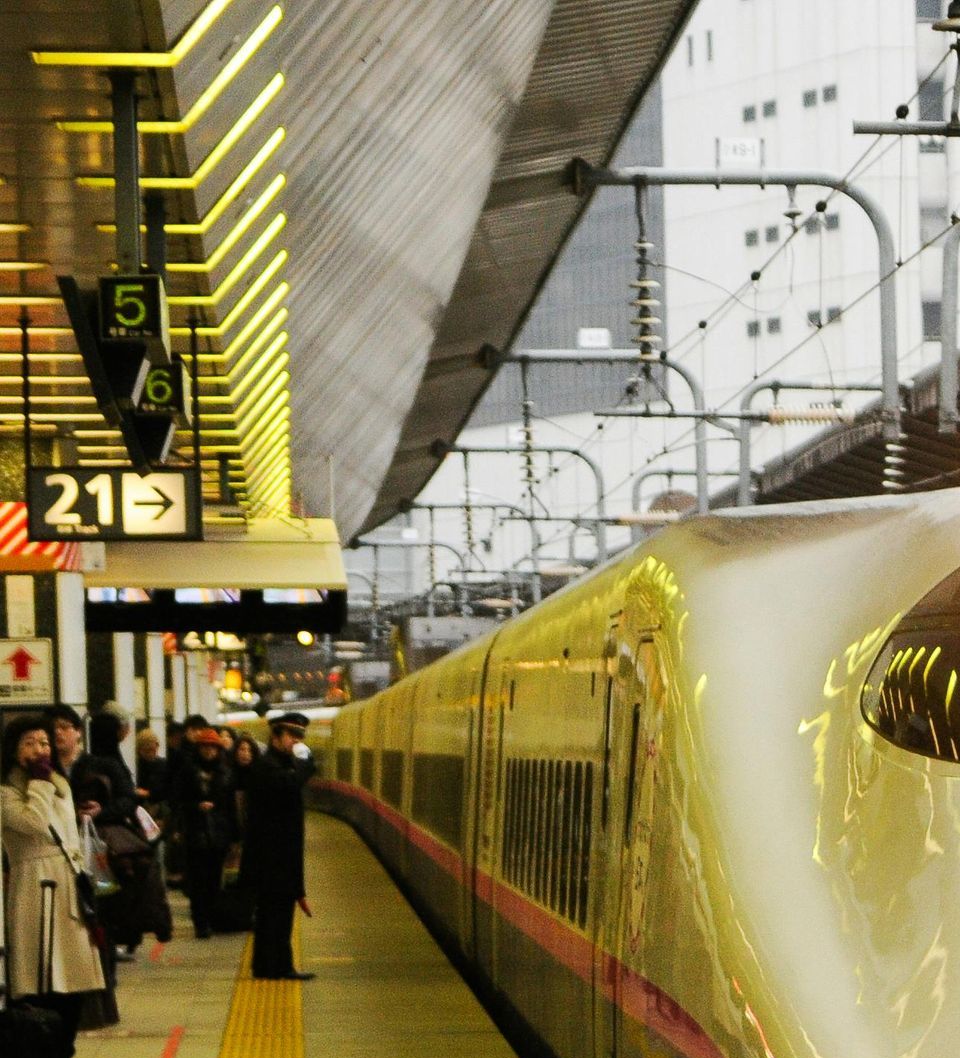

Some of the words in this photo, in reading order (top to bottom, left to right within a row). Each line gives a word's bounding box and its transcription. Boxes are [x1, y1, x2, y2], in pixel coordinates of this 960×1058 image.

[114, 284, 147, 327] 5
[146, 369, 172, 403] 6
[44, 473, 114, 526] 21
